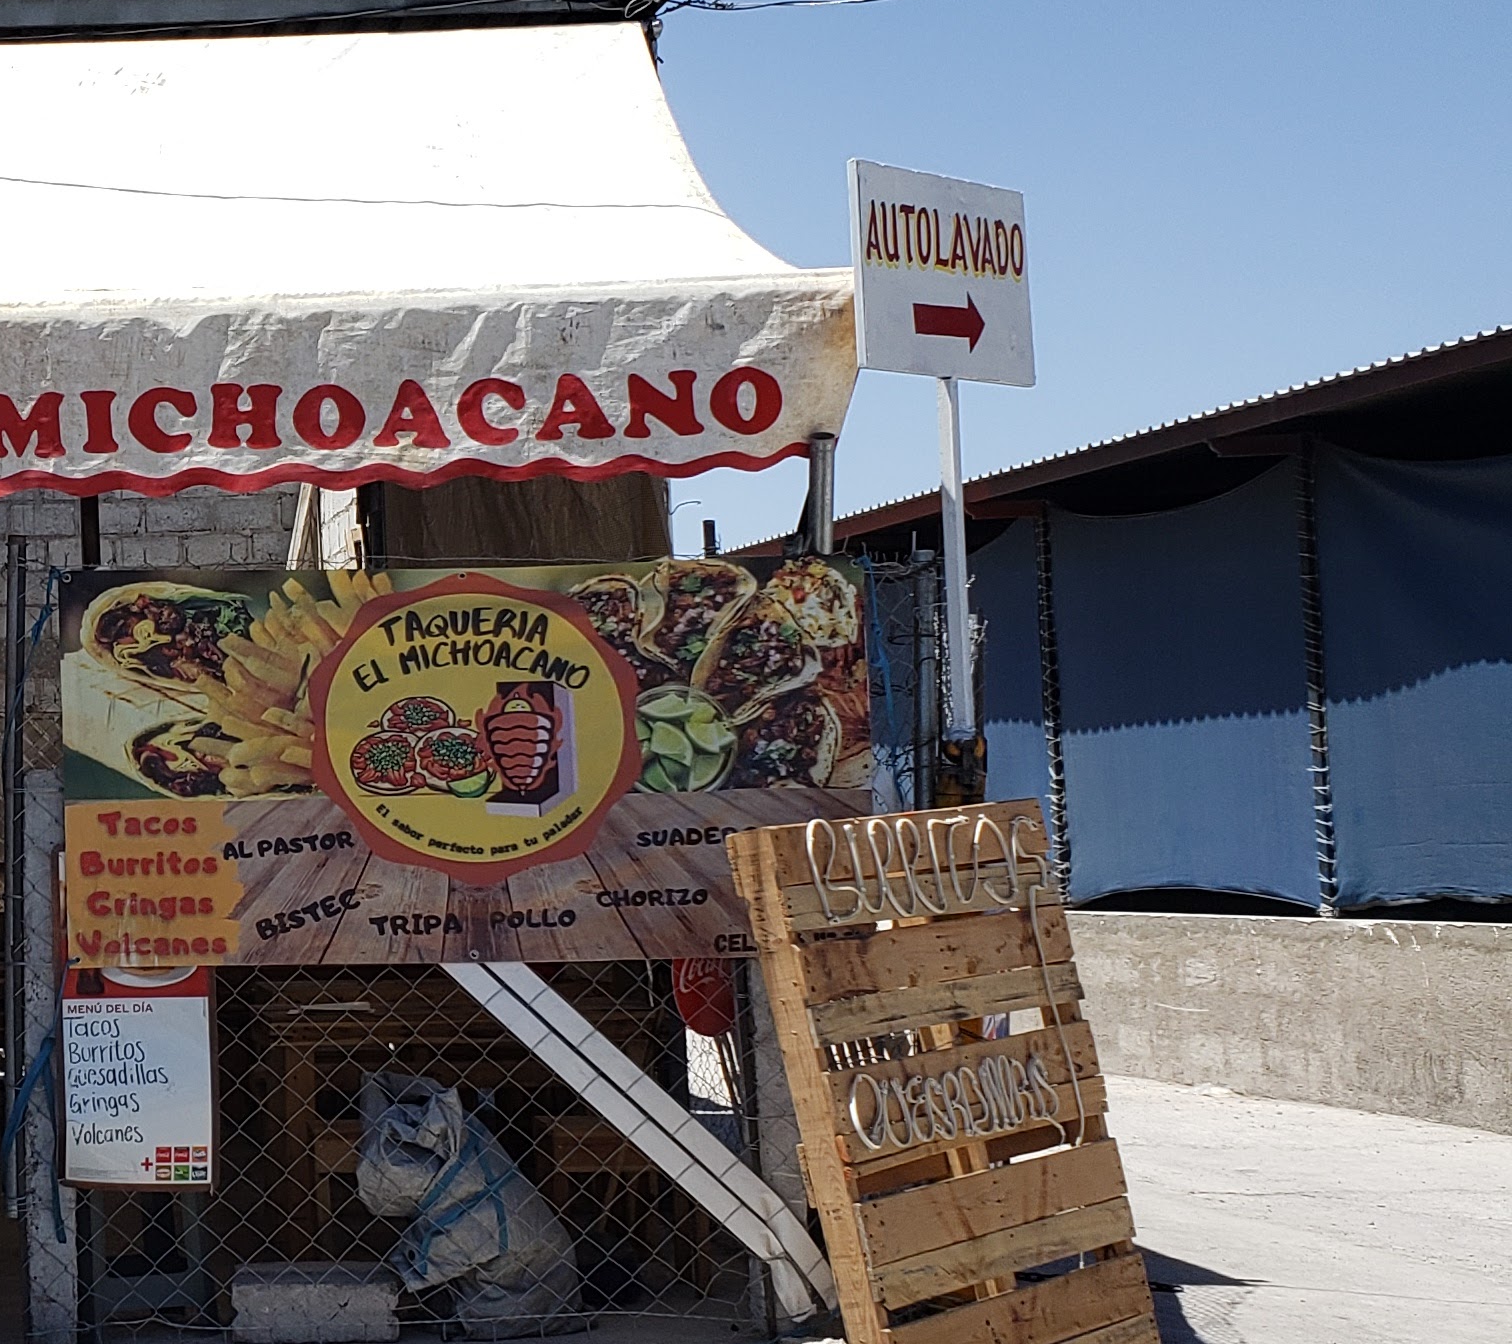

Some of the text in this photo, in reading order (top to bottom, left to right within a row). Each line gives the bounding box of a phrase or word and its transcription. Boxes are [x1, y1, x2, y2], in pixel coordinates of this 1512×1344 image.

[865, 198, 1024, 282] AUTOLAVADO
[378, 607, 549, 646] TAQUERIA
[399, 639, 591, 690] MICHOACANO
[98, 811, 197, 836] Tacos
[392, 818, 425, 841] sabor
[428, 838, 485, 856] perfecto
[490, 843, 518, 856] para
[523, 837, 538, 849] tu
[542, 806, 584, 843] paladar
[223, 830, 355, 861] AL PASTOR
[636, 826, 759, 848] SUADE
[80, 851, 218, 877] Burritos
[86, 891, 214, 920] Gringas
[595, 888, 708, 907] CHORIZO
[255, 888, 361, 941] BISTEC
[368, 913, 463, 938] TRIPA
[490, 909, 576, 930] POLLO
[76, 930, 228, 957] Volcanes
[67, 1001, 153, 1014] MENÚ DEL DÍA
[64, 1016, 121, 1038] Tacos
[69, 1041, 146, 1064] Burritos
[68, 1062, 169, 1088] Quesadillas
[70, 1092, 140, 1117] Gringas
[72, 1123, 144, 1146] Volcanes
